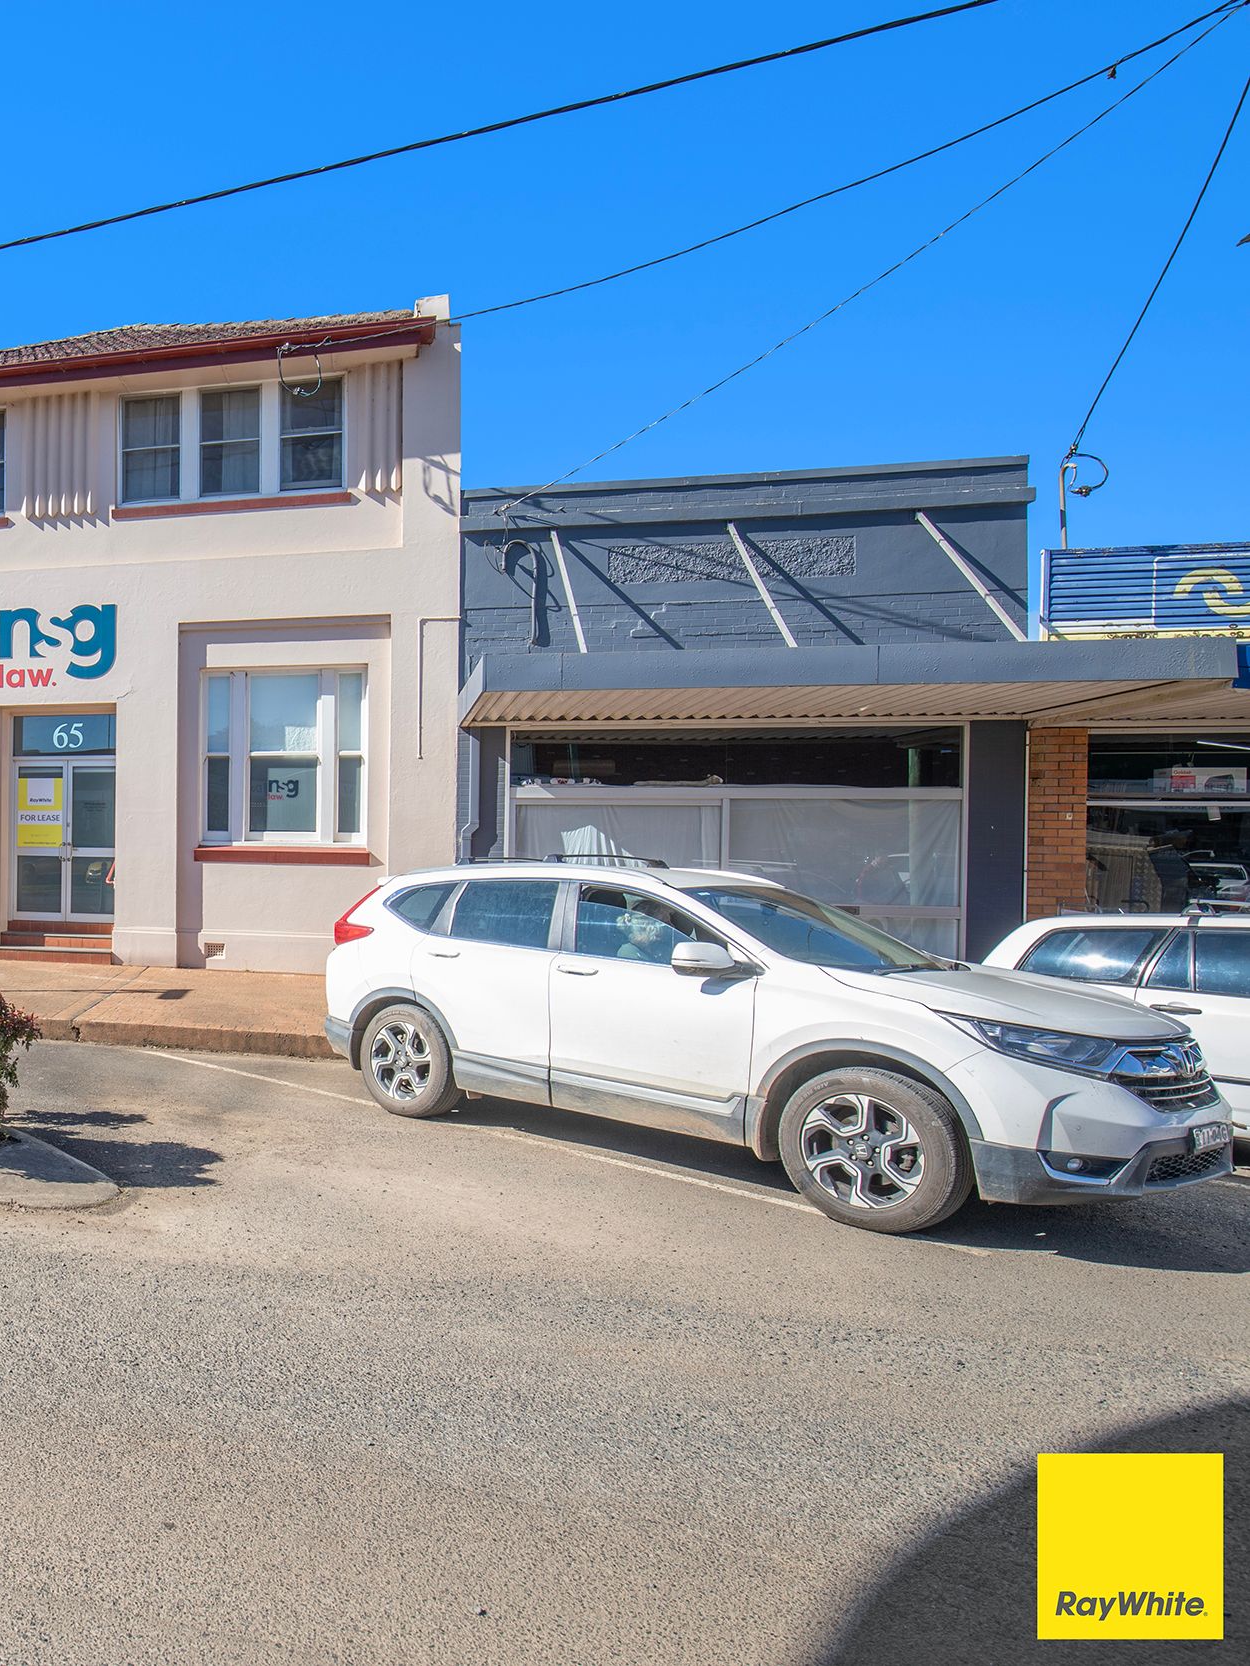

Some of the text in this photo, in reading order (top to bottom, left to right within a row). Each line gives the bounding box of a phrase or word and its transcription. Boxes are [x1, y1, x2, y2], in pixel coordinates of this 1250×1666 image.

[52, 722, 84, 749] 65
[268, 779, 299, 798] nsg
[37, 814, 61, 822] LEASE
